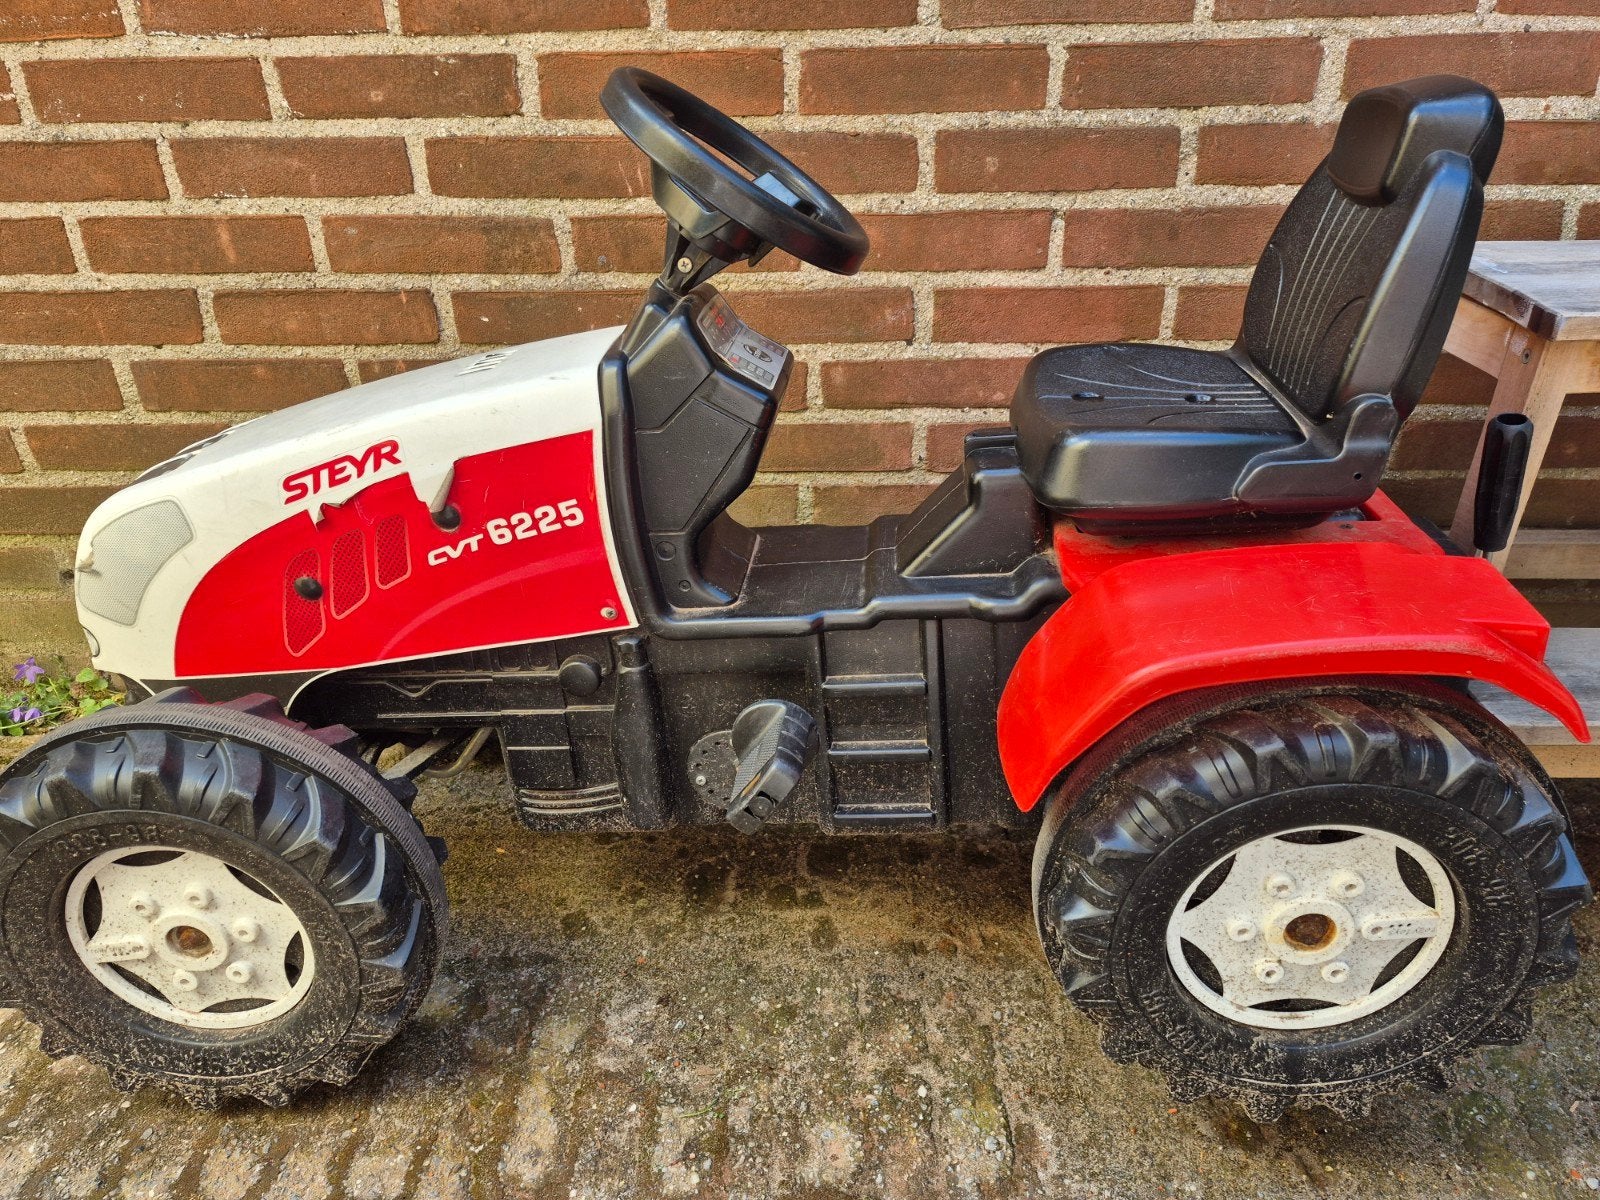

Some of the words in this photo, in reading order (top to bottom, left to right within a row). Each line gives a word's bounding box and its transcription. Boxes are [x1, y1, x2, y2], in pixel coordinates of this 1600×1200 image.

[282, 439, 402, 505] STEYR
[427, 533, 484, 566] CVT
[486, 498, 585, 545] 6225
